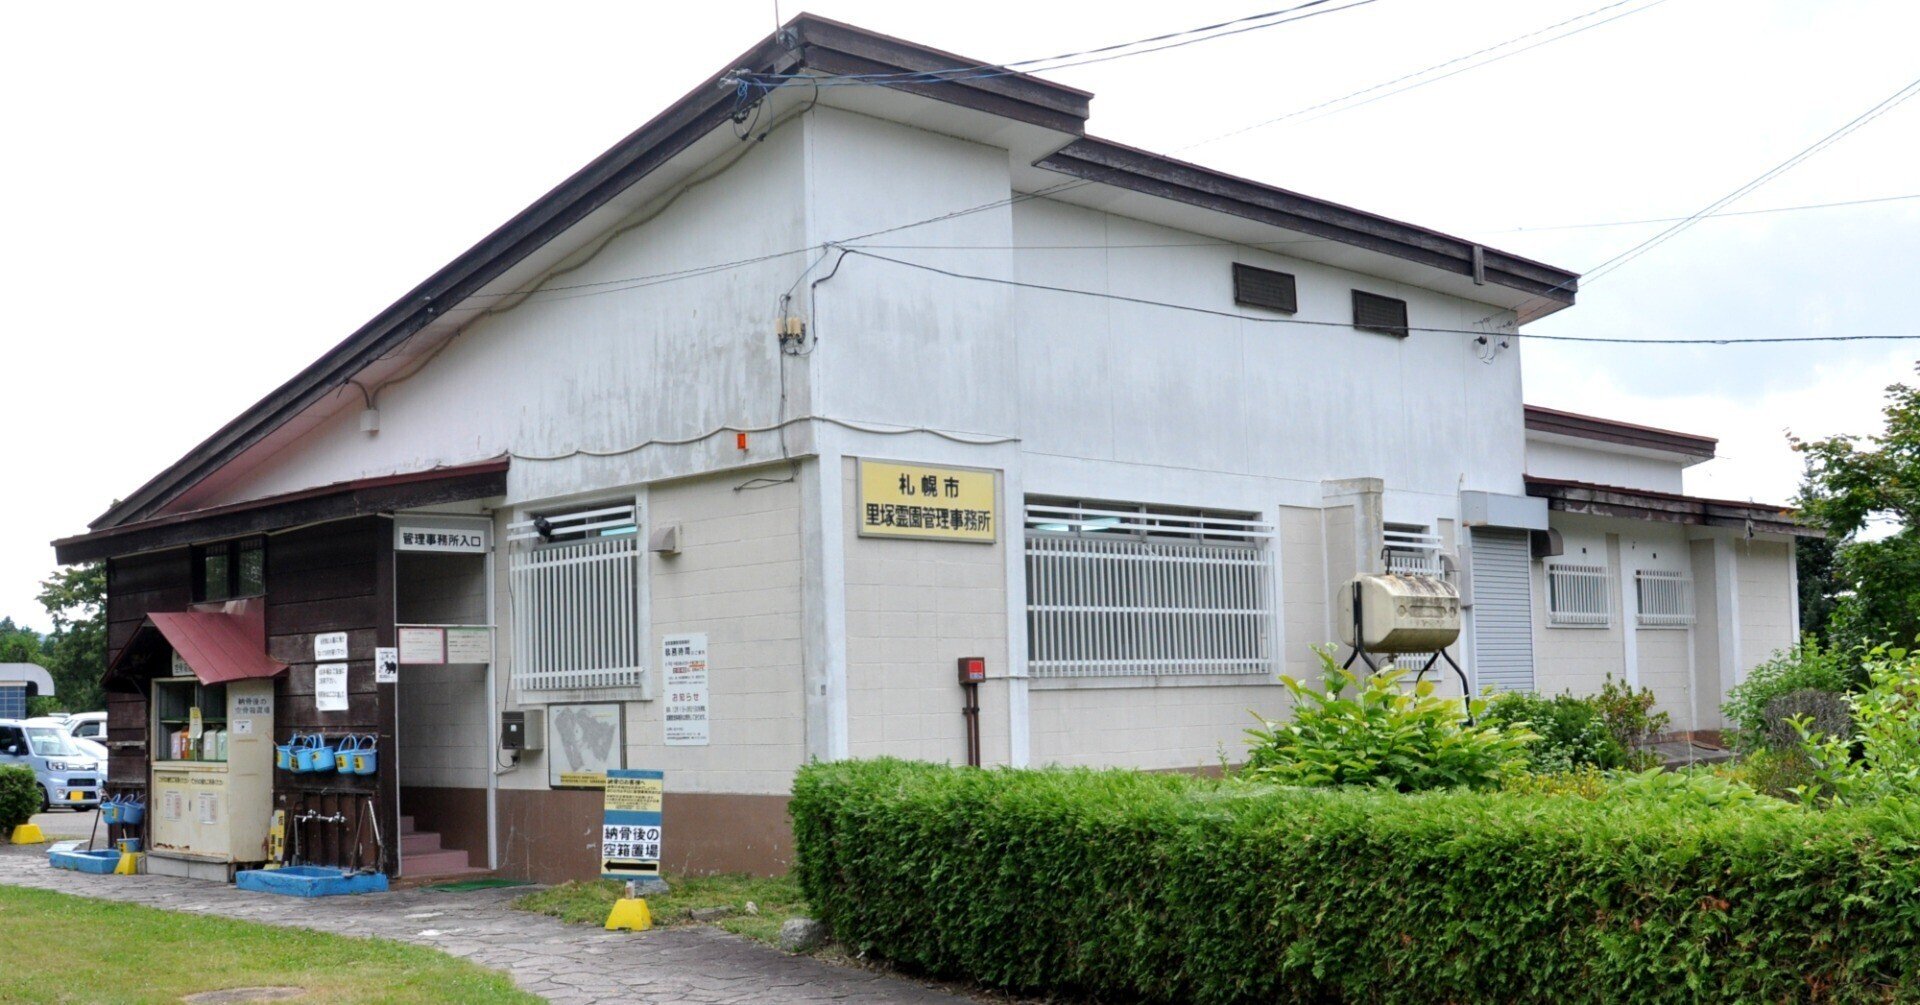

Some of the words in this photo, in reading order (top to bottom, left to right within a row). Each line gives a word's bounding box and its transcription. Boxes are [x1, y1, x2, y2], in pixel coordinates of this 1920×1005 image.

[899, 472, 960, 498] 札幌市
[865, 502, 991, 532] 里塚霊園管理事務所
[403, 532, 481, 547] 管理事務所入口
[672, 692, 699, 702] お知らせ
[604, 826, 659, 841] 納骨後の
[603, 843, 658, 857] 空箱置場
